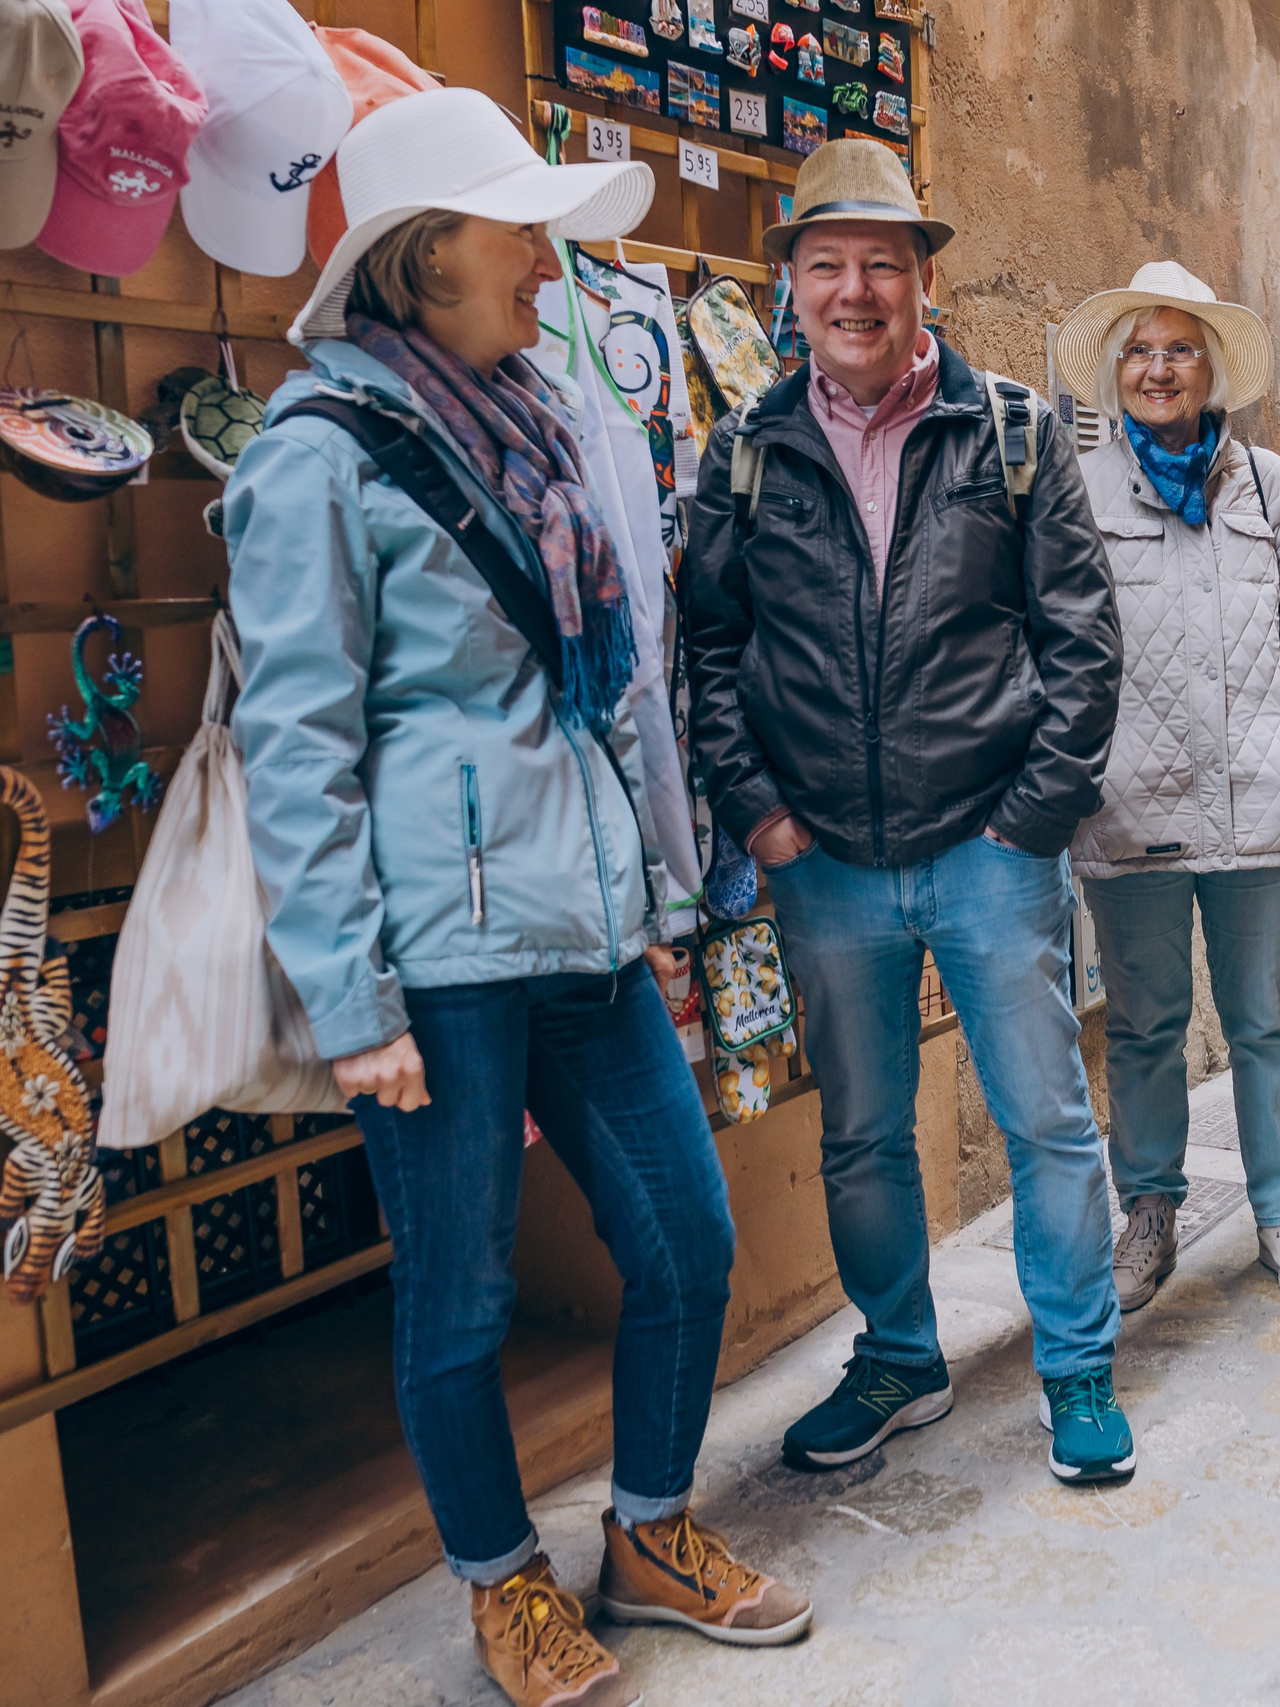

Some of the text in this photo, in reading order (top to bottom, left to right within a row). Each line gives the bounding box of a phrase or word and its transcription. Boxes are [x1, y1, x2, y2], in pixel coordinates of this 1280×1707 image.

[734, 98, 760, 124] 2,55
[592, 126, 623, 152] 3,95
[110, 146, 174, 180] MALLORCA
[685, 149, 711, 175] 5,95
[735, 1005, 776, 1032] Mallorca
